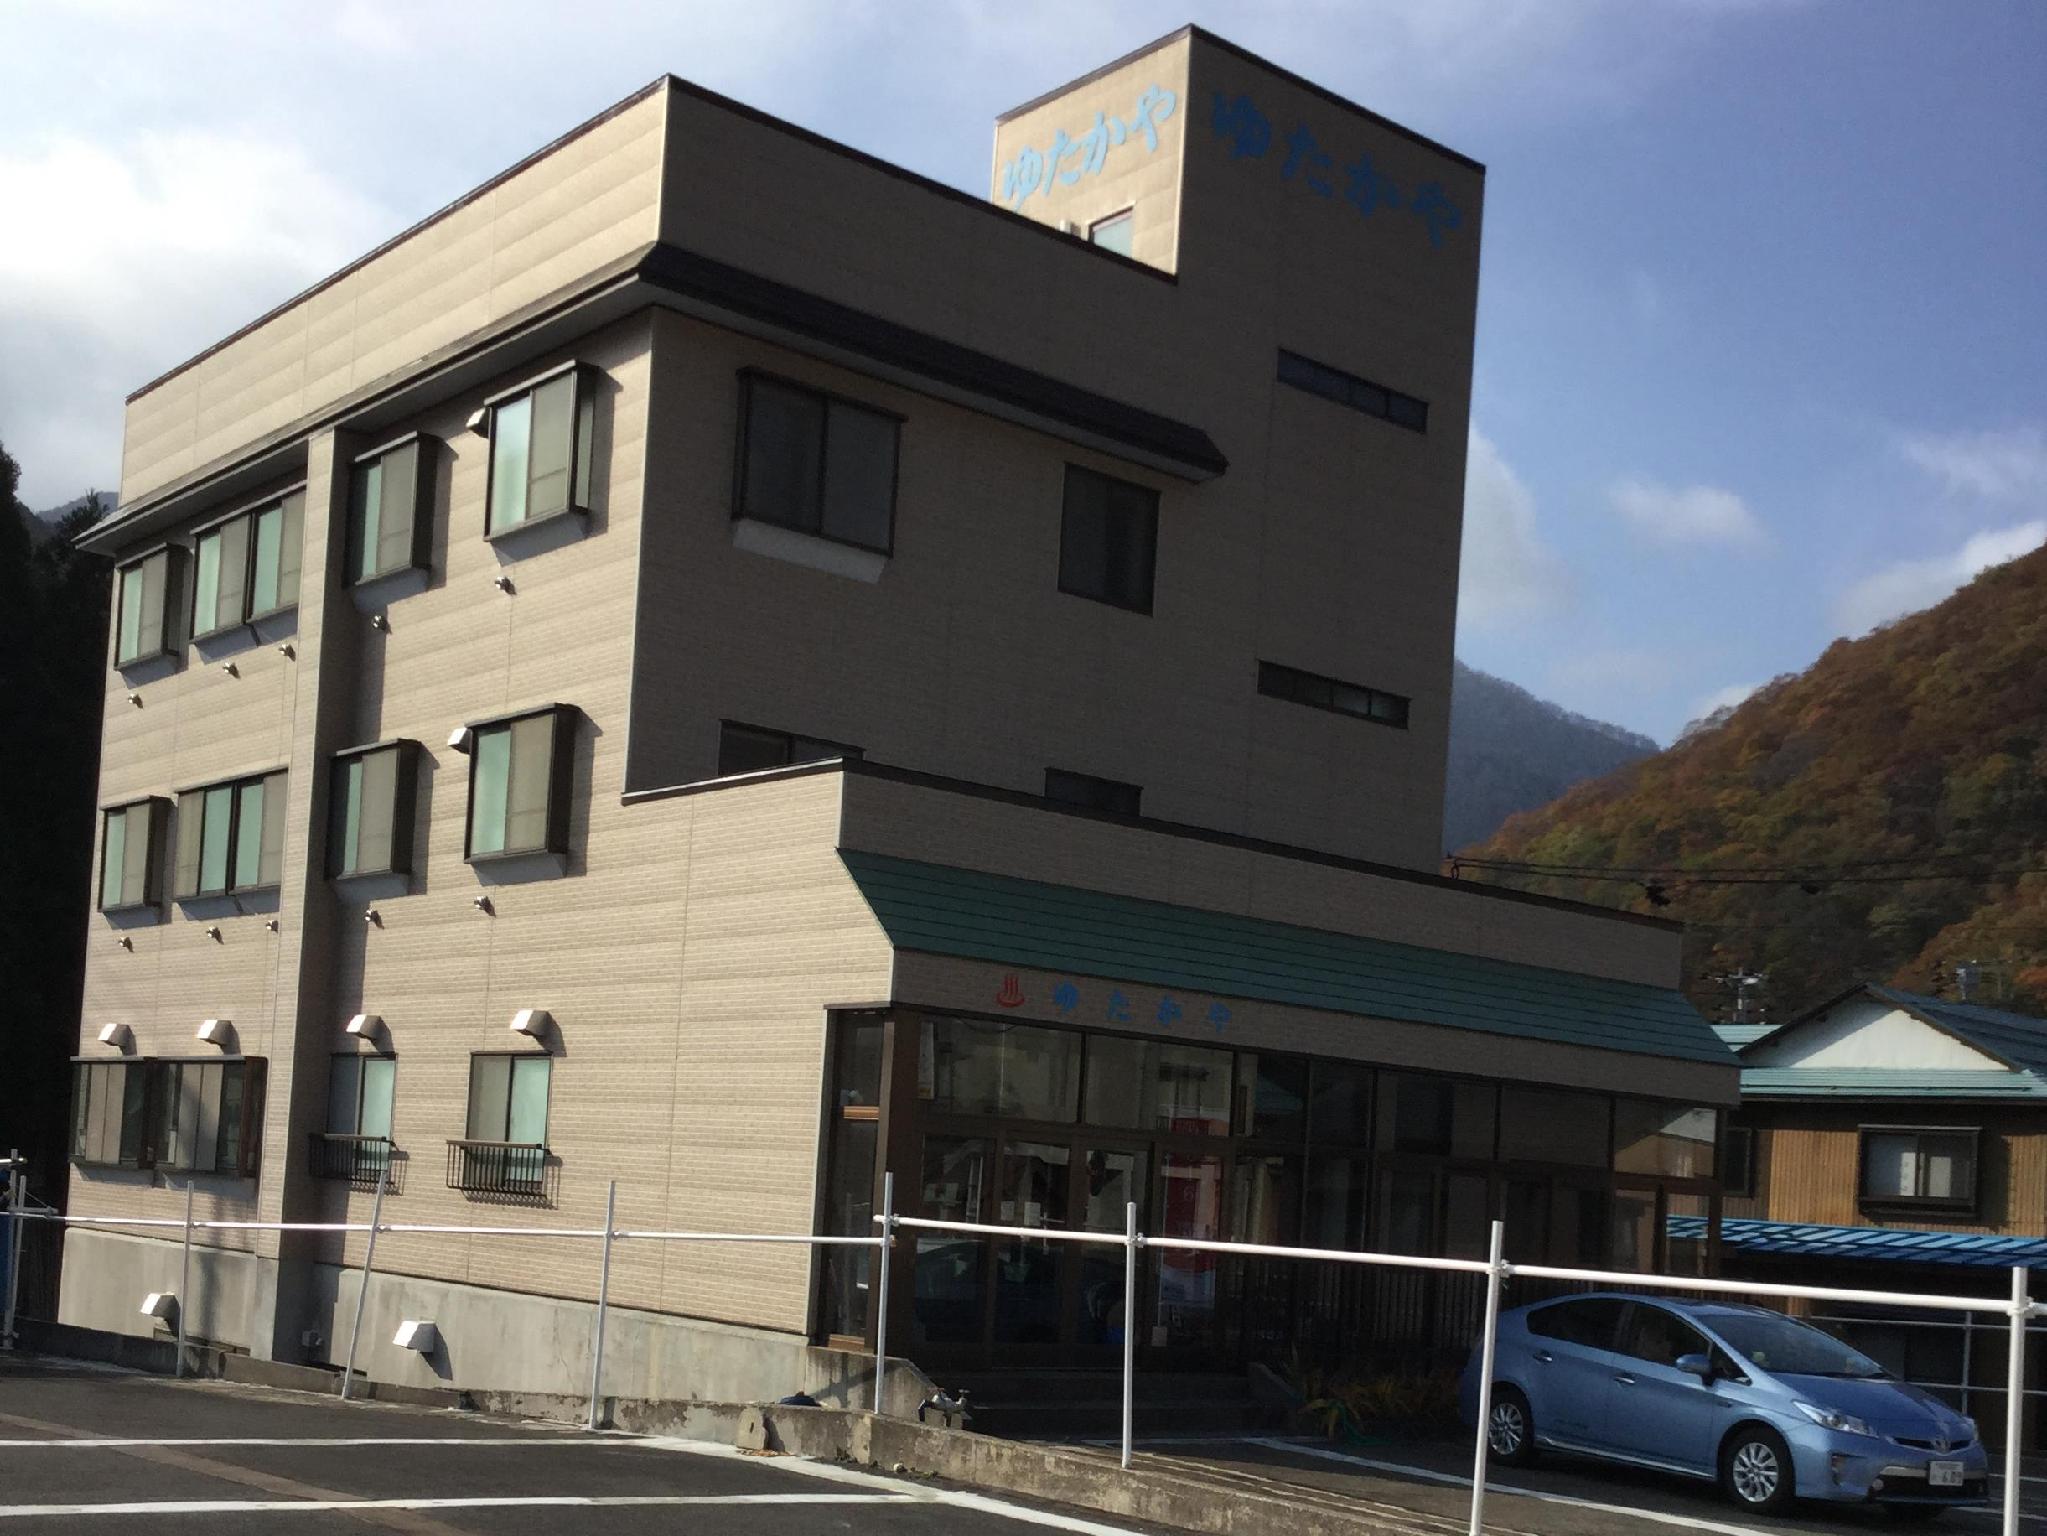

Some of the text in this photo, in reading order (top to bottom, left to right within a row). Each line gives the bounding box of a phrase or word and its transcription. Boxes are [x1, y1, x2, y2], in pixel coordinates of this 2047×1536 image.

[1002, 83, 1177, 211] ゆたかや
[1212, 93, 1462, 249] ゆたかや
[1054, 980, 1232, 1033] ゆたかや
